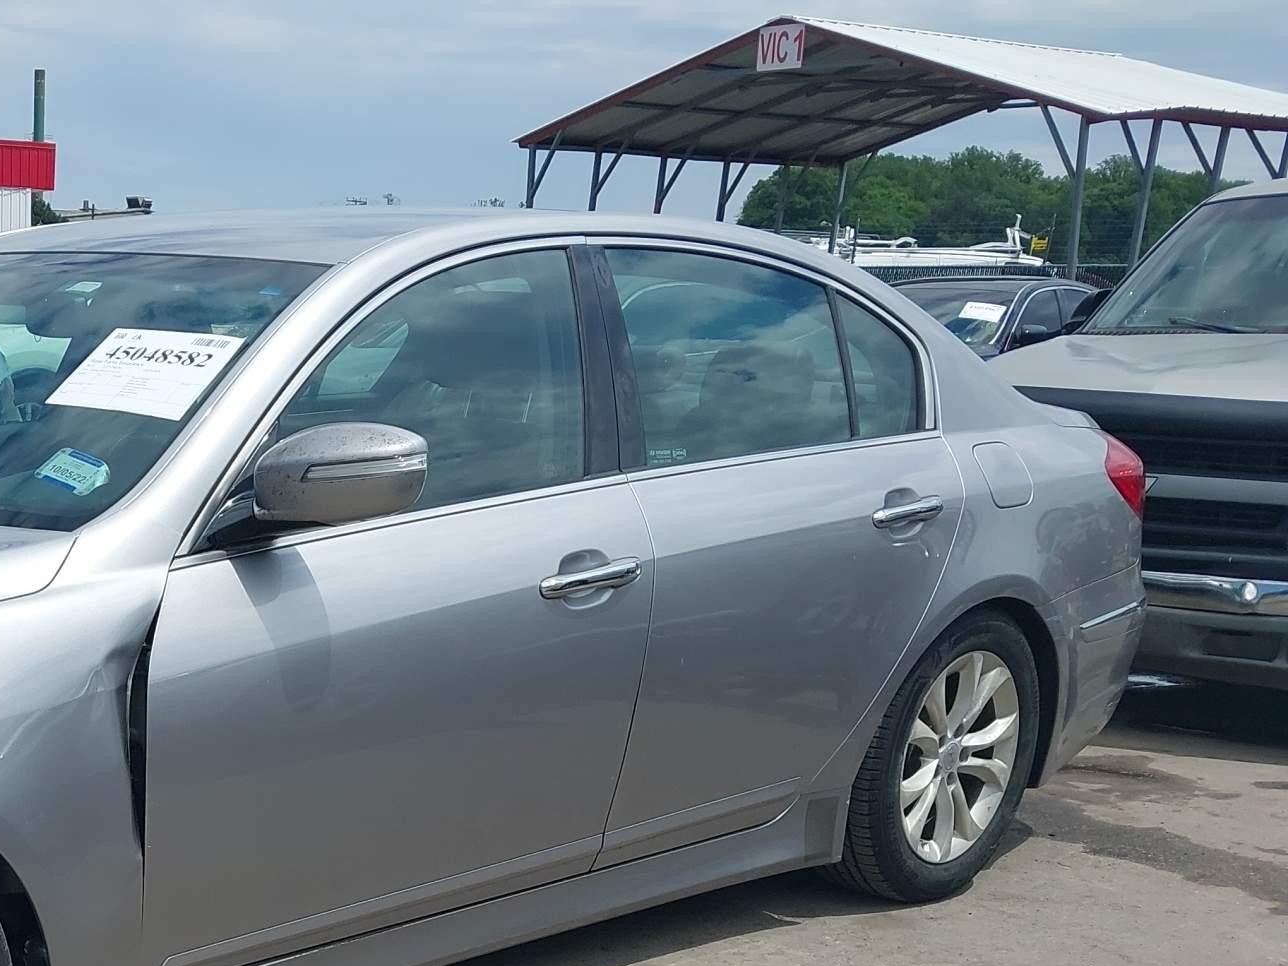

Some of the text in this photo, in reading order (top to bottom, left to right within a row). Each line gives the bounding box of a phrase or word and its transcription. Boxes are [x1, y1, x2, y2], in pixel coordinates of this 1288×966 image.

[760, 28, 804, 65] VIC 1
[105, 345, 214, 368] 45048582
